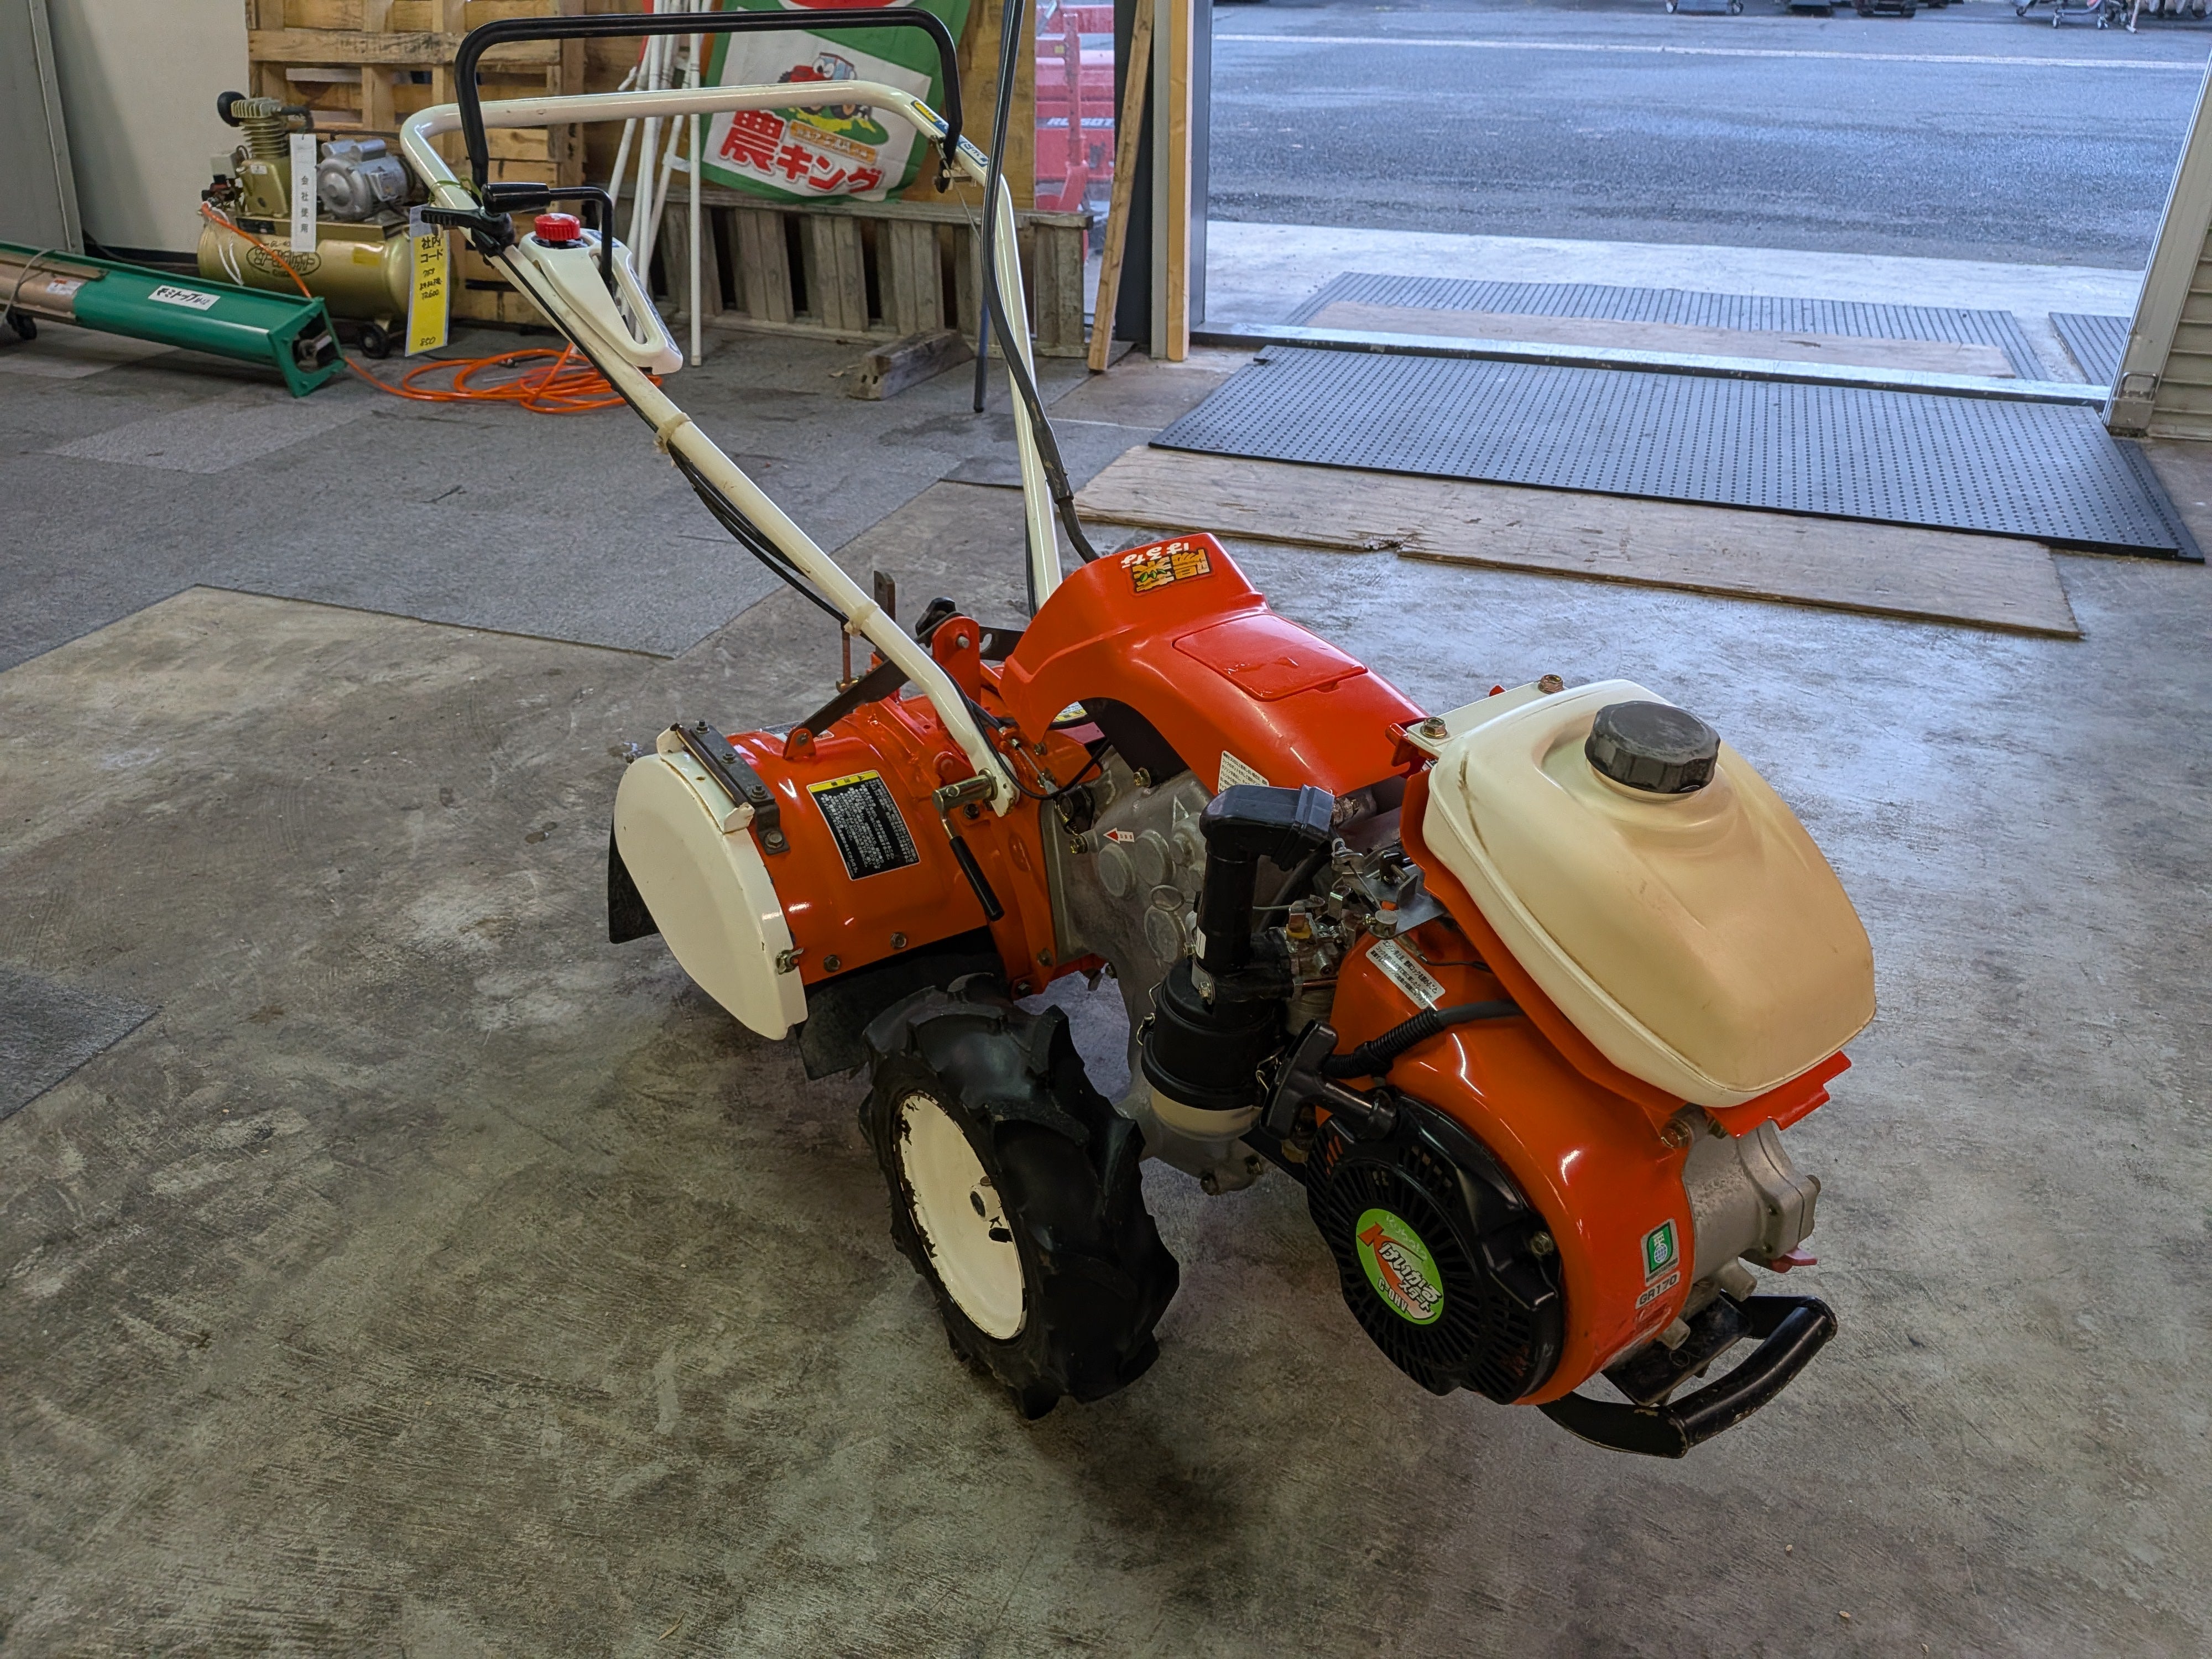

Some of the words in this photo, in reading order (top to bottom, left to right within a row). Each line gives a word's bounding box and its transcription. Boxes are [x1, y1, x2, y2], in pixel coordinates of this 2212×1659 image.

[719, 109, 883, 194] 農キング
[420, 248, 444, 263] コード
[421, 236, 441, 250] 社内
[1120, 542, 1189, 569] はるな
[1132, 549, 1211, 592] 陽菜
[1378, 1242, 1443, 1305] けいかる
[1639, 1274, 1677, 1305] GR170
[1398, 1279, 1431, 1313] スタート
